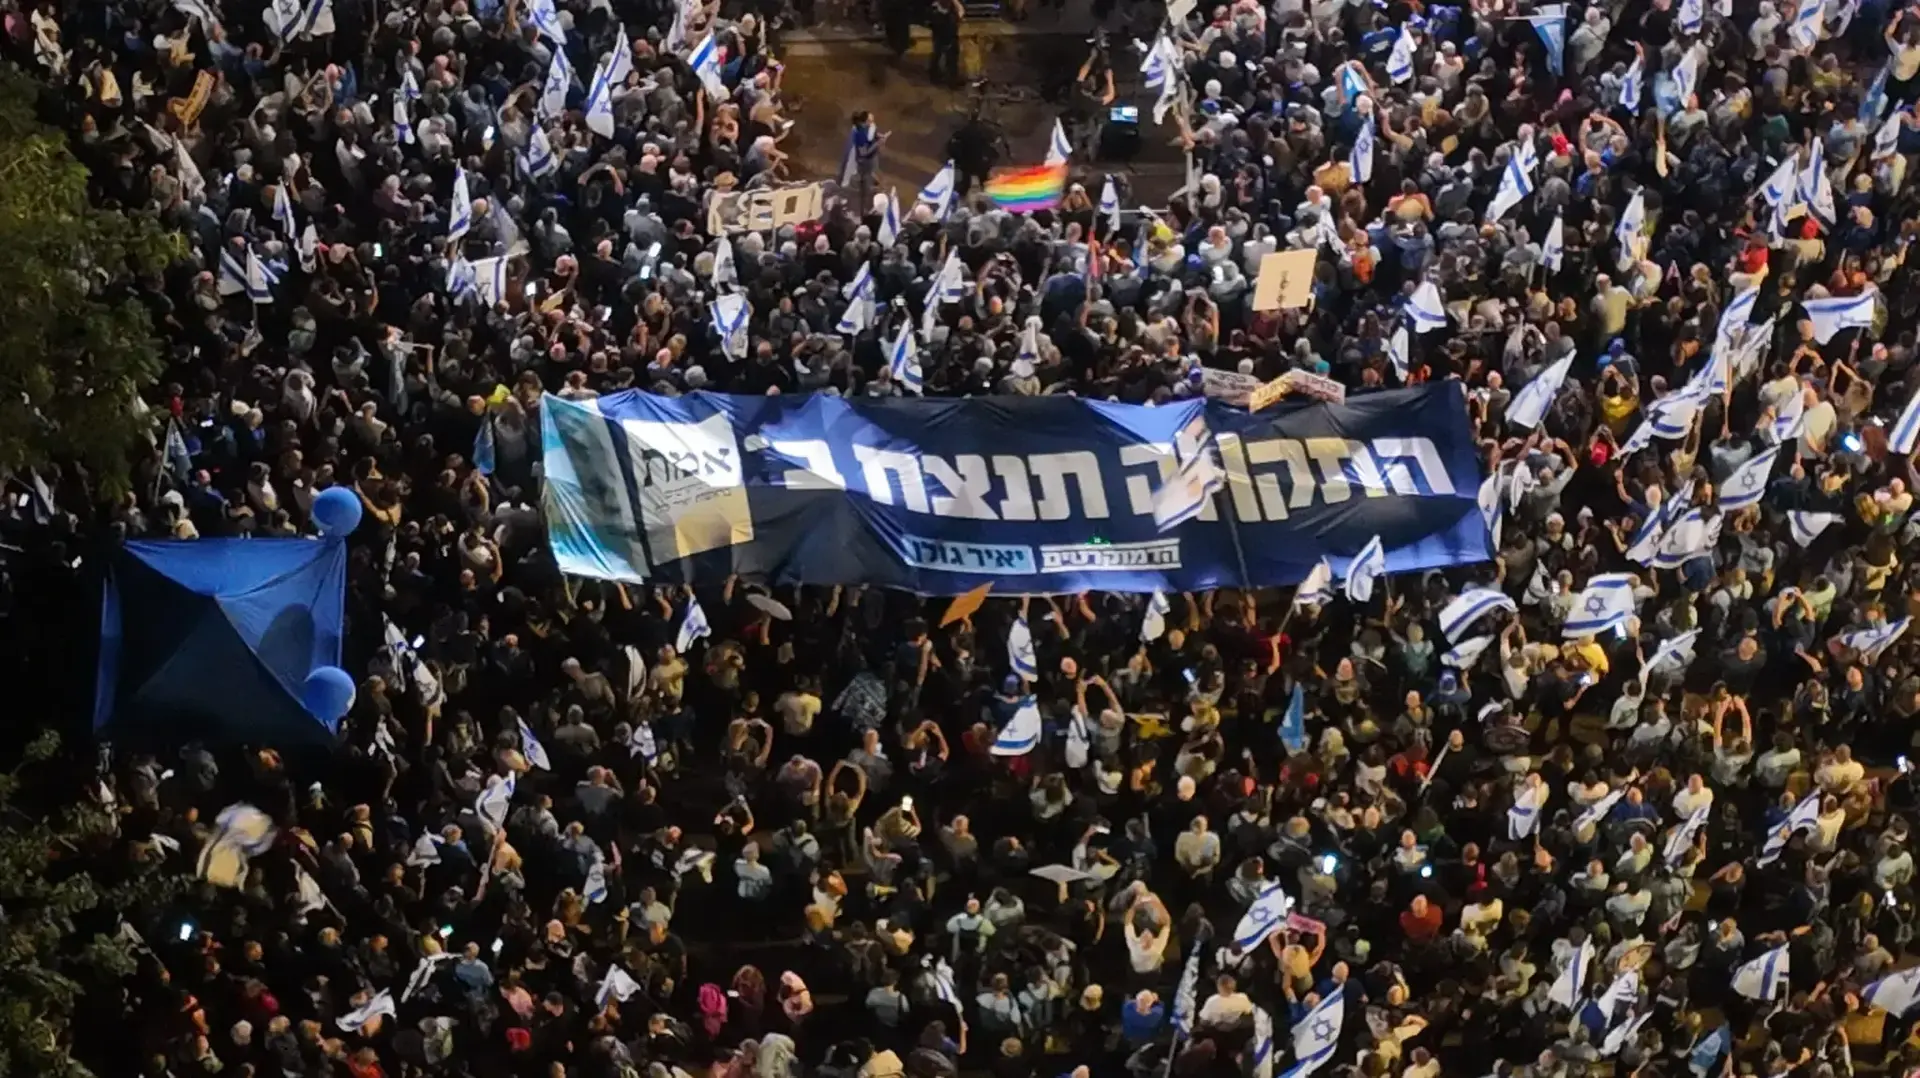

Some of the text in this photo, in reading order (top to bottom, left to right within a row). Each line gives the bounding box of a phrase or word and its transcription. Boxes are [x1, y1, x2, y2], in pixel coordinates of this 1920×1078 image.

[641, 447, 733, 487] אמת
[853, 443, 1109, 522] תנצח
[1120, 433, 1455, 523] התקוה
[912, 540, 1024, 568] יאיר גולן
[1042, 545, 1179, 569] הדמוקרטים
